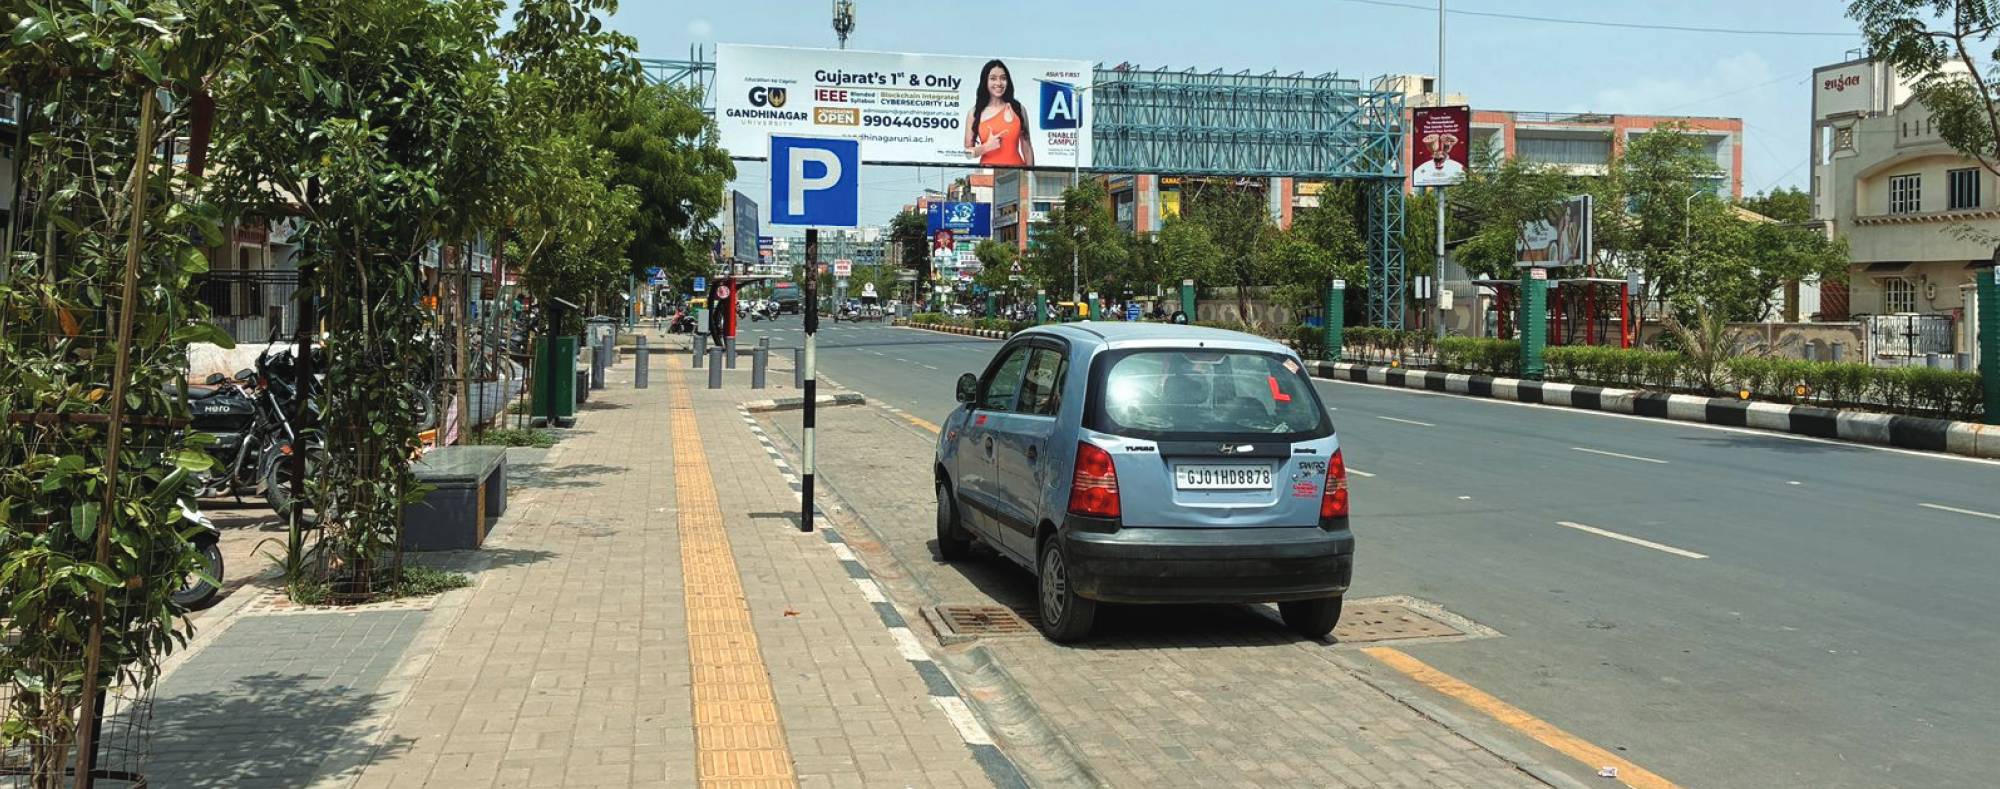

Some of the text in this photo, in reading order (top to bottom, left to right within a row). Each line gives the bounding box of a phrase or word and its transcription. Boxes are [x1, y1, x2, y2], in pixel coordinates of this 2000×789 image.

[815, 69, 887, 86] Gujarat's
[909, 73, 920, 87] &
[924, 74, 961, 90] Only
[814, 88, 848, 103] IEEE
[880, 91, 921, 99] Blockchain
[880, 98, 960, 108] CYBERSECURITY LAB
[726, 108, 809, 121] GANDHINAGAR
[817, 111, 854, 124] OPEN
[740, 119, 794, 127] UNIVERSITY
[863, 115, 960, 129] 9904405900
[788, 147, 842, 216] P
[1267, 375, 1292, 402] L
[1187, 469, 1271, 485] GJ01HD8878
